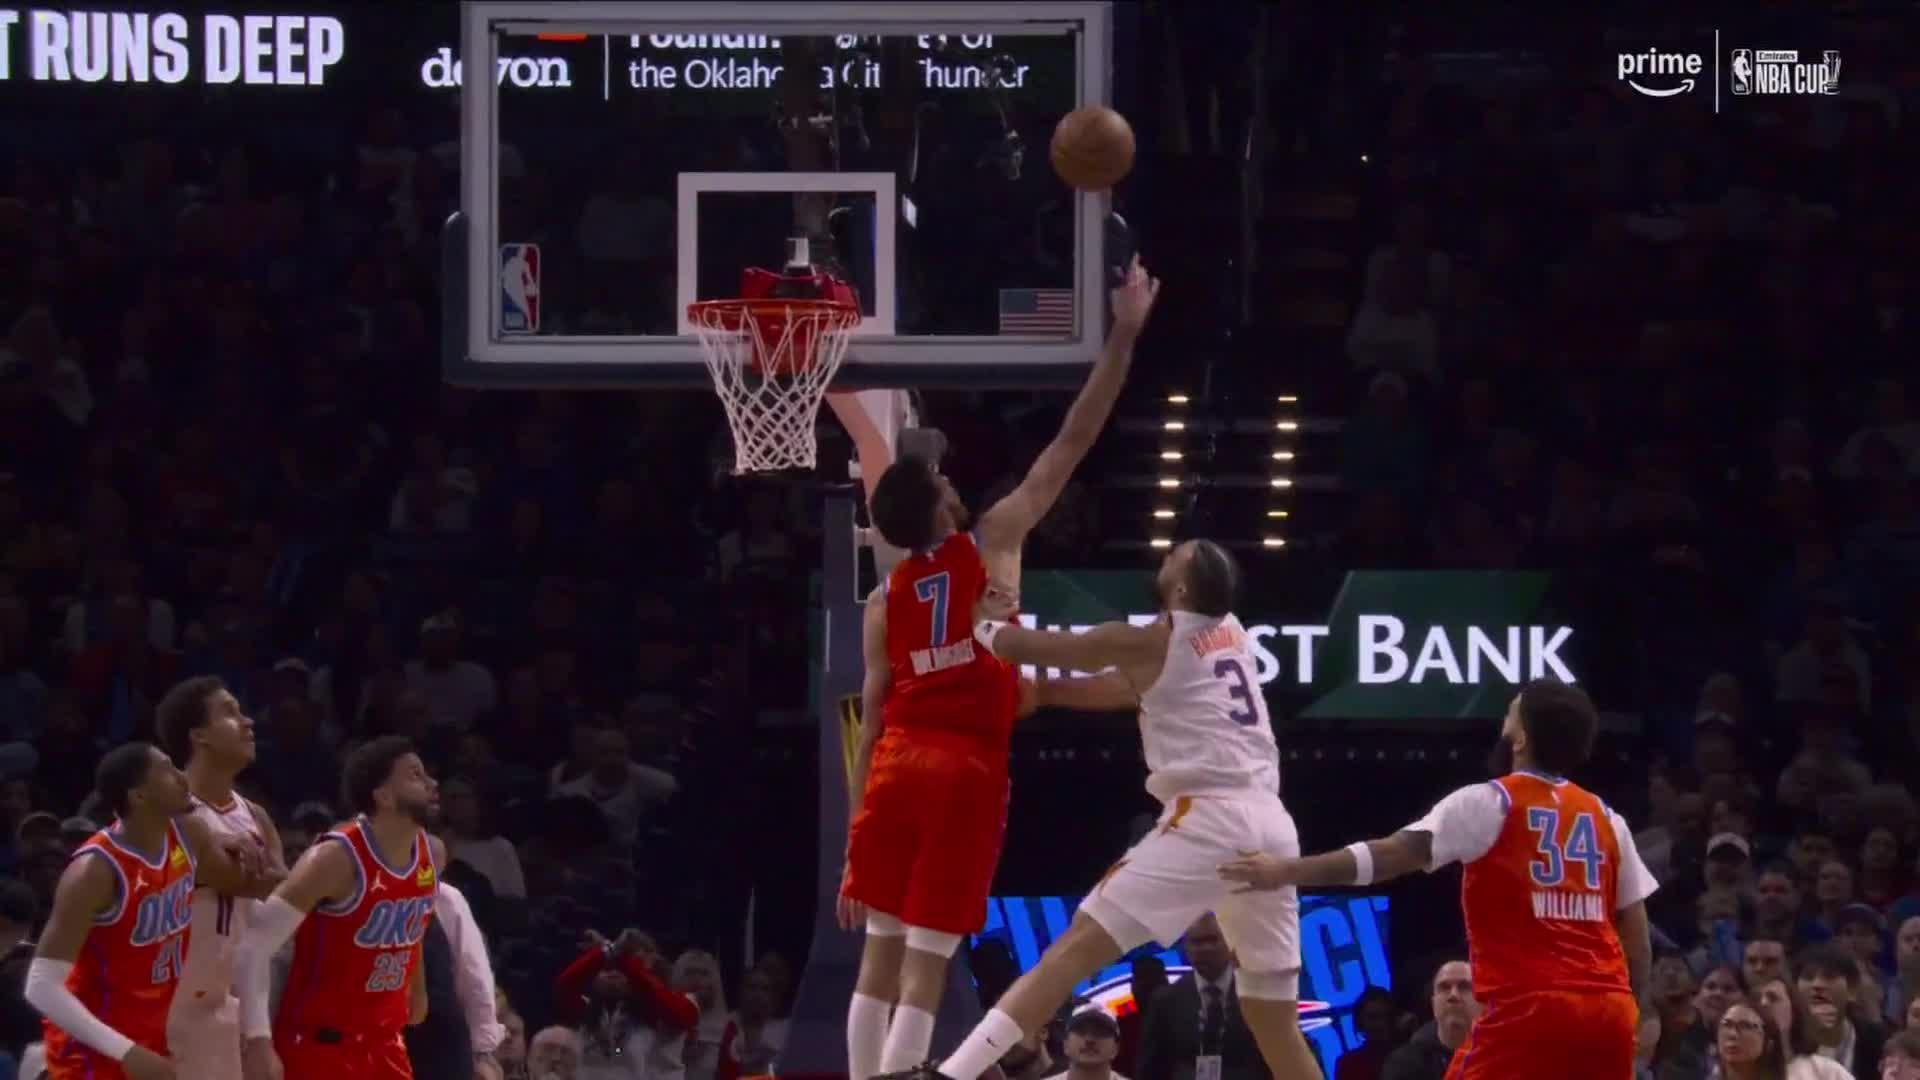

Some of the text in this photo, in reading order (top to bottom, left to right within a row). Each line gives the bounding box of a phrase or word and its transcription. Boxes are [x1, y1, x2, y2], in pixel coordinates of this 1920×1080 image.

[31, 10, 190, 84] RUNS
[204, 14, 345, 85] DEEP
[628, 57, 677, 89] the
[914, 571, 950, 648] 7
[1357, 614, 1577, 685] BANK
[1213, 658, 1259, 726] 3
[1526, 806, 1606, 890] 34
[365, 949, 411, 993] 25
